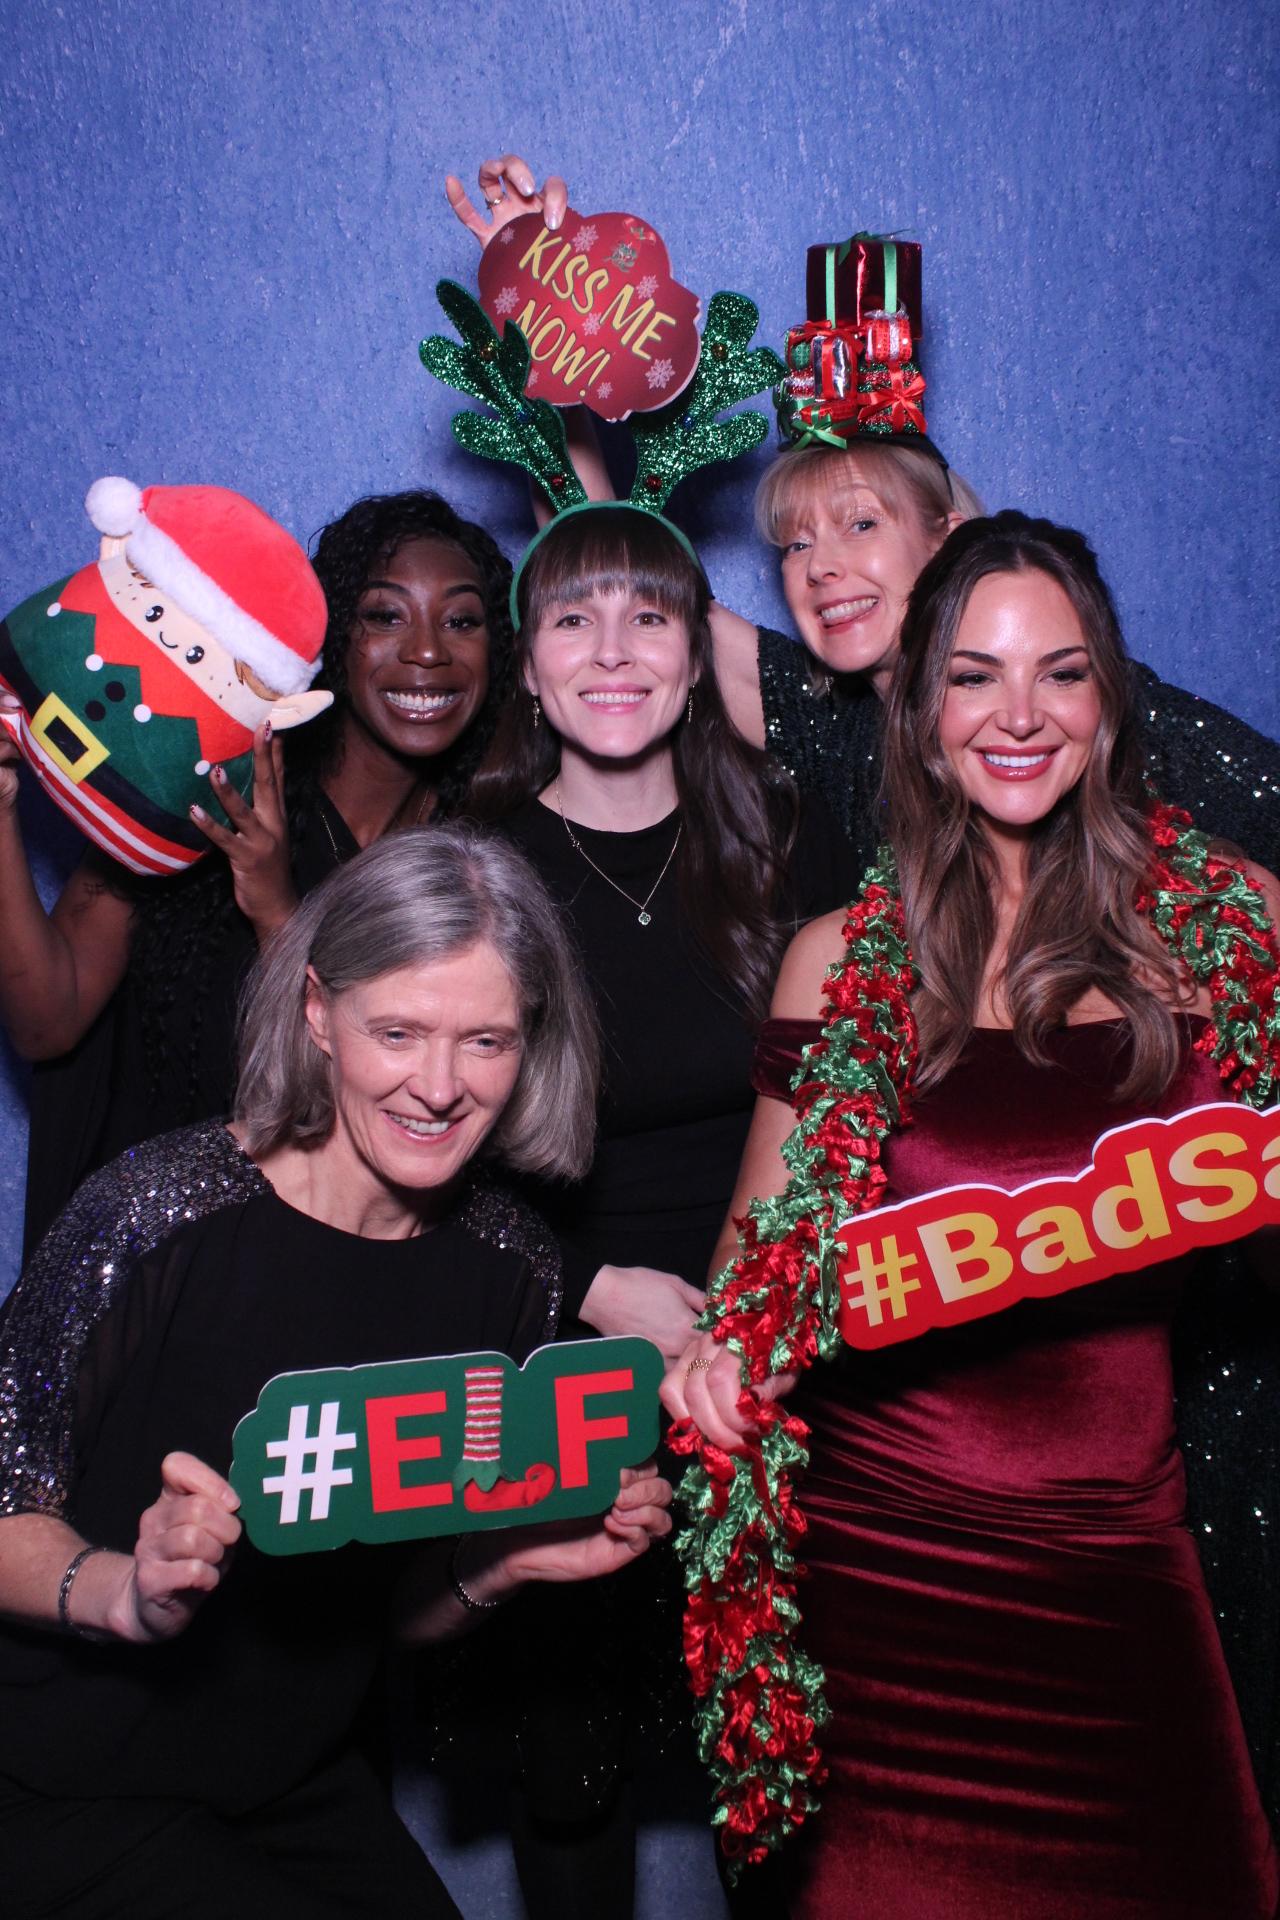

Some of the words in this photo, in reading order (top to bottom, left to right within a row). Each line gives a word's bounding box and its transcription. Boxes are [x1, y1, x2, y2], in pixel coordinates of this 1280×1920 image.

[514, 299, 611, 398] NOW!
[518, 226, 610, 315] KISS
[599, 283, 677, 361] ME
[843, 1131, 1280, 1328] #BadS
